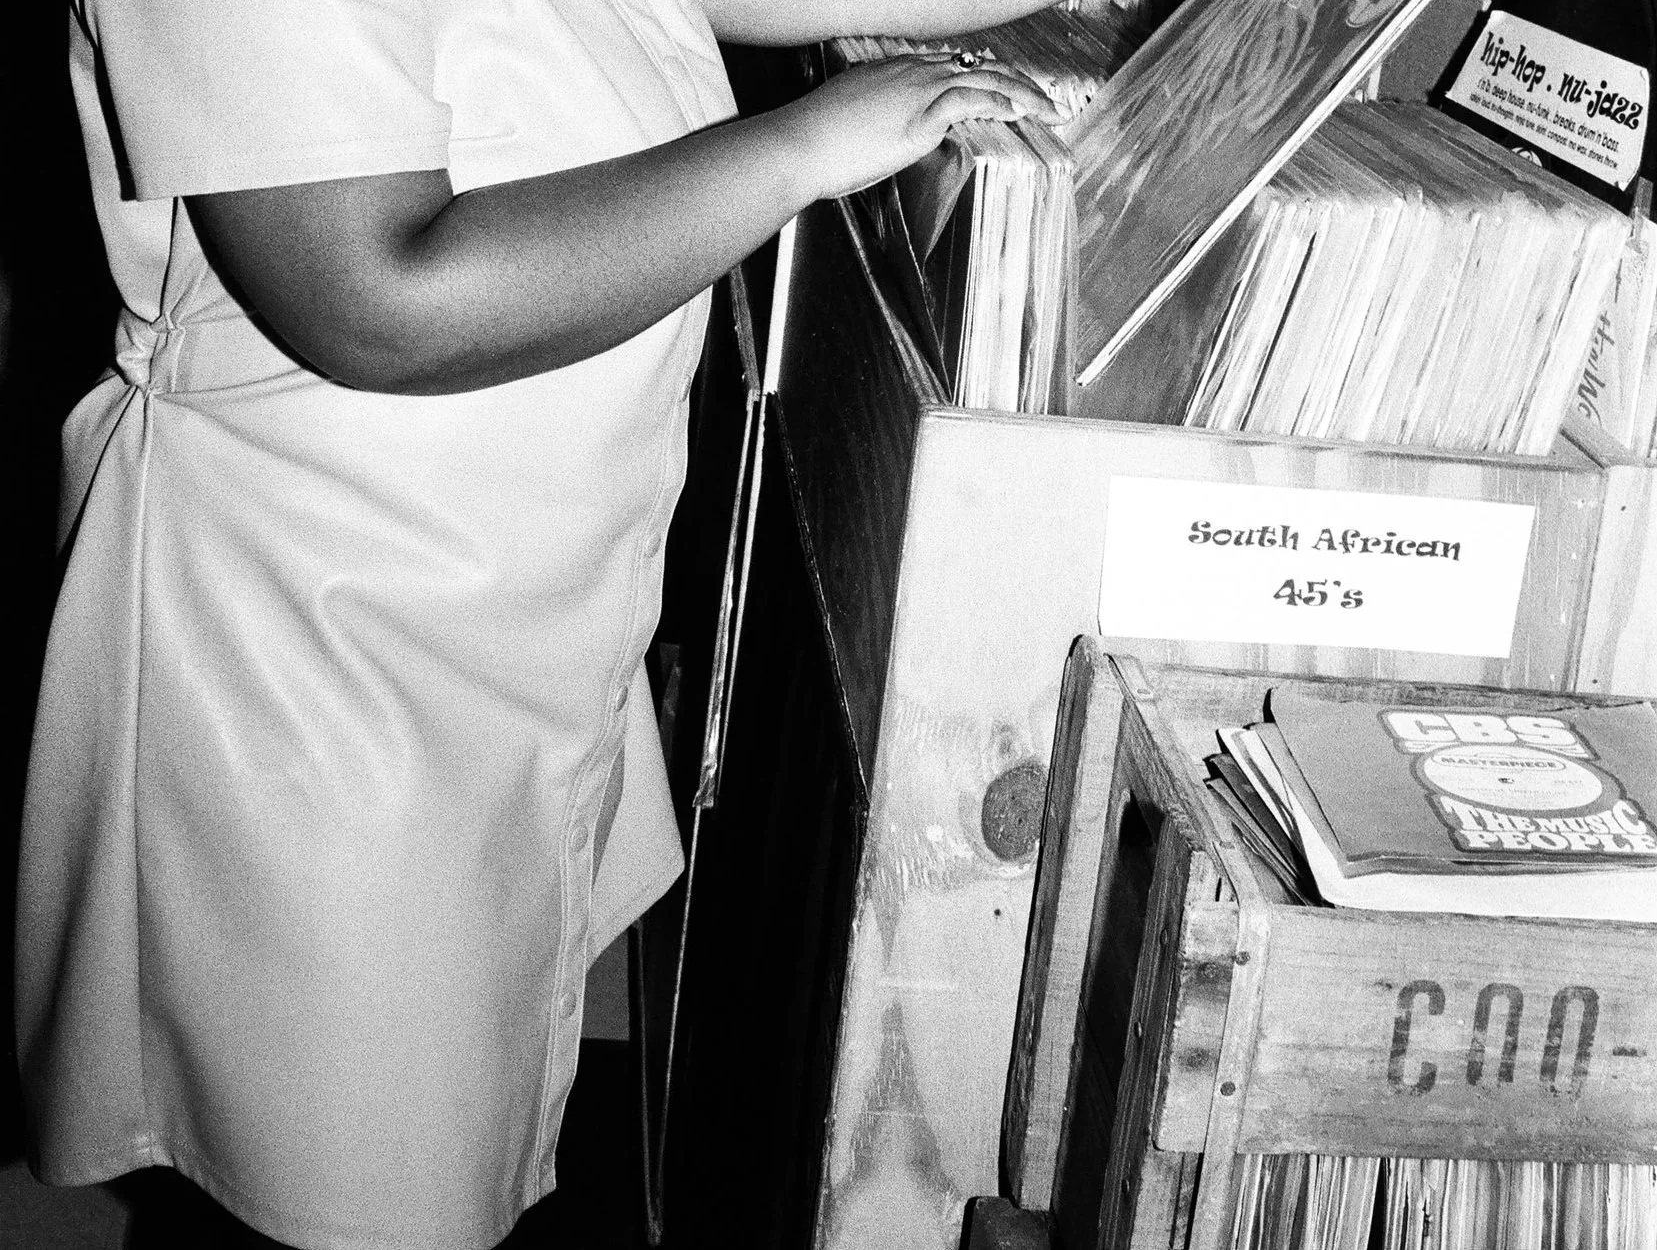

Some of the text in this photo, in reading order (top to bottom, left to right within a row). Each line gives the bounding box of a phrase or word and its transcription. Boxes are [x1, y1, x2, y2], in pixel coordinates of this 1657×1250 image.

[1480, 31, 1546, 92] hip-hop
[1557, 72, 1644, 130] nu-jazz
[1188, 520, 1462, 561] South African
[1272, 578, 1364, 610] 45's
[1386, 711, 1578, 747] CBS
[1441, 757, 1557, 769] MASTERPIECE
[1439, 796, 1648, 836] THE MUSIC
[1460, 829, 1657, 852] PEOPLE
